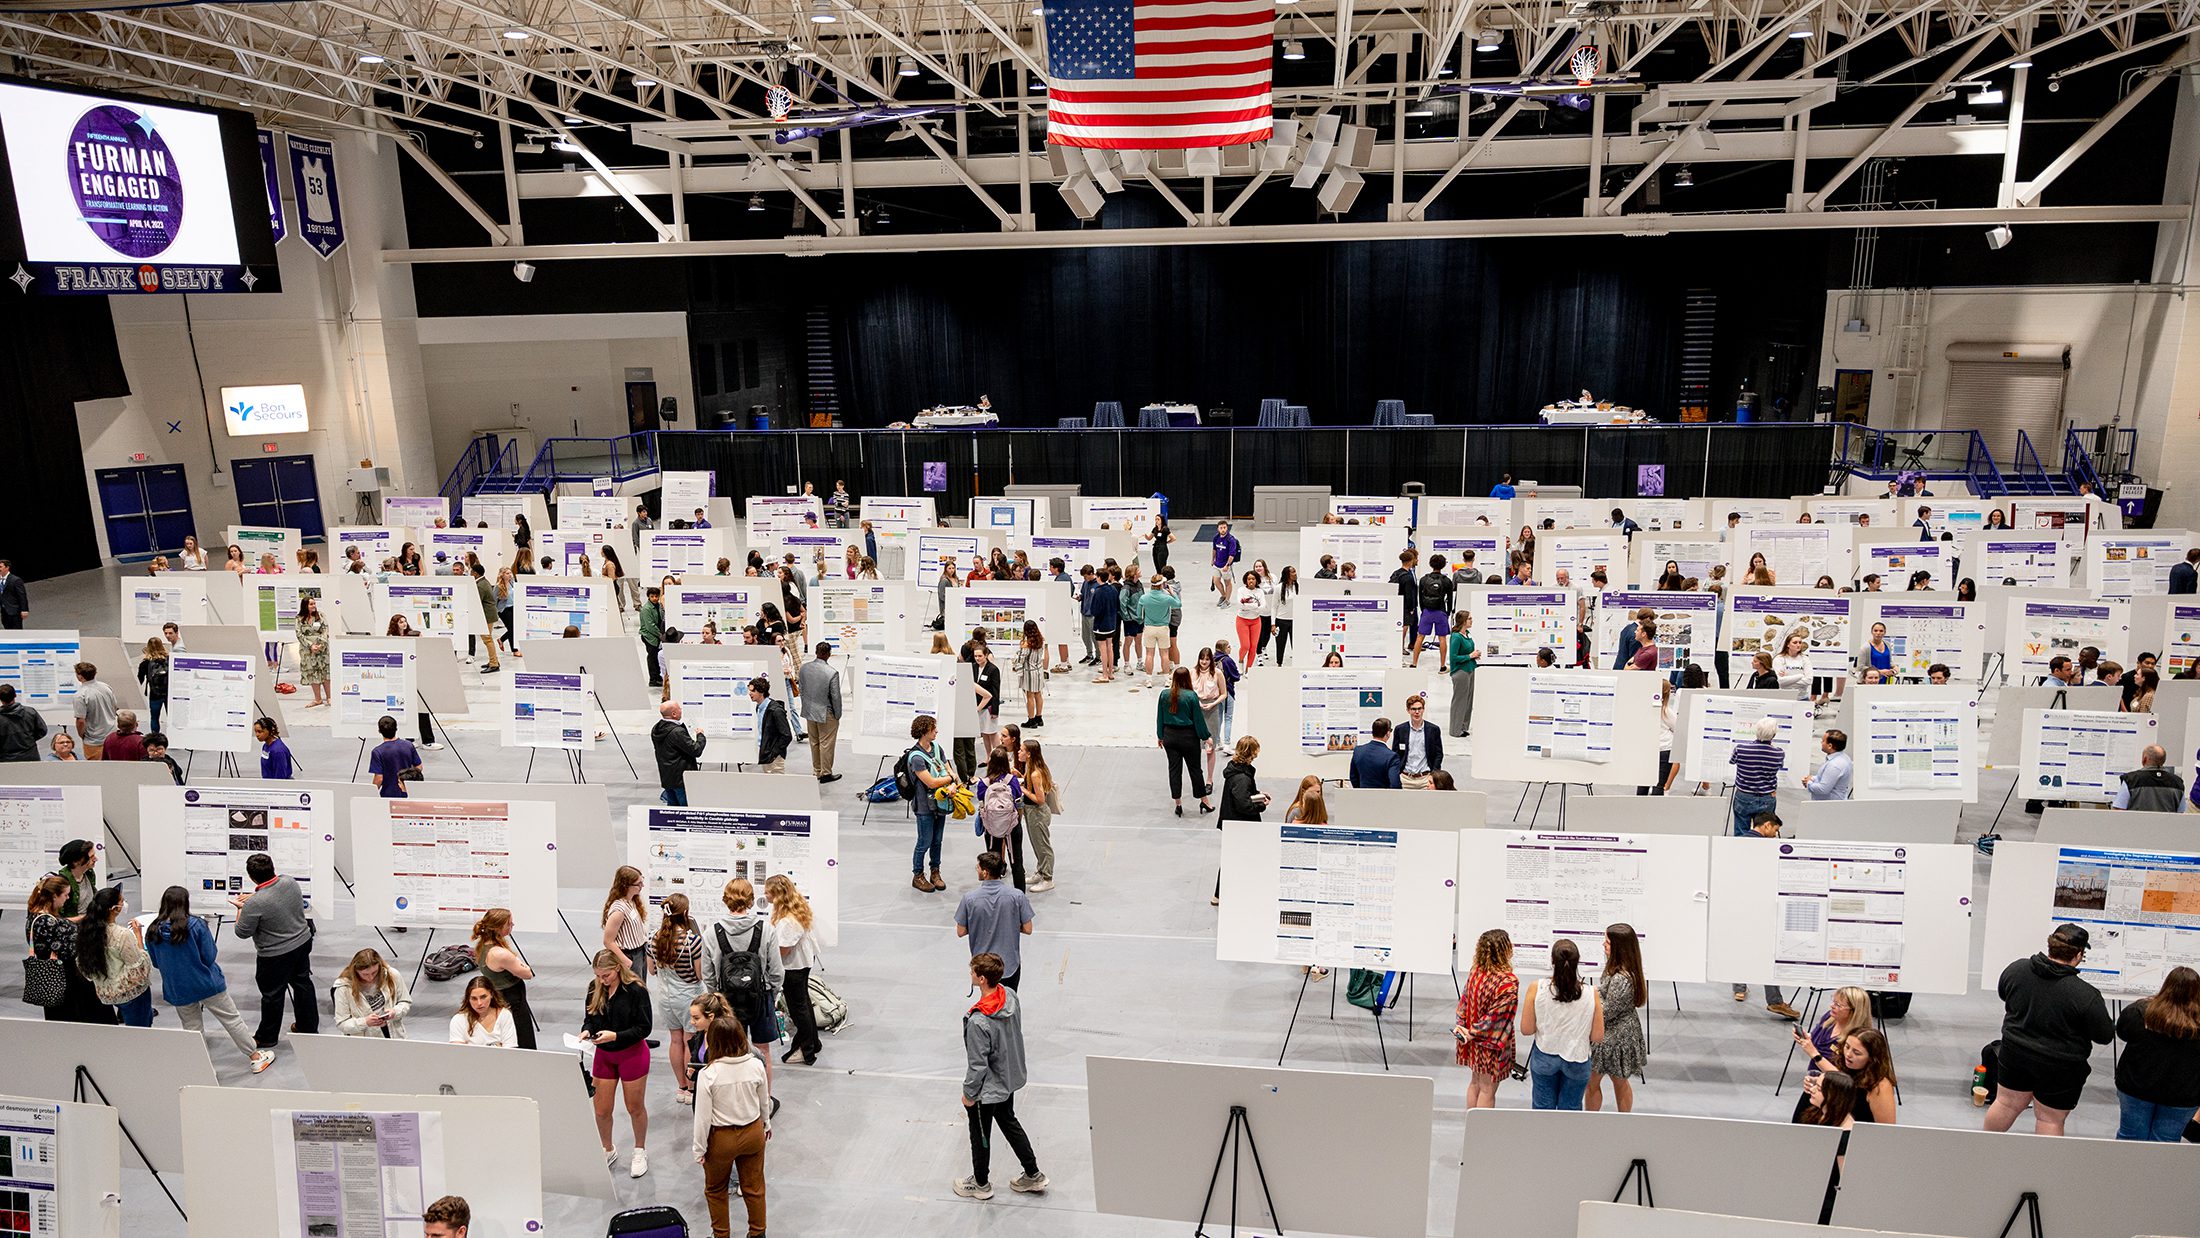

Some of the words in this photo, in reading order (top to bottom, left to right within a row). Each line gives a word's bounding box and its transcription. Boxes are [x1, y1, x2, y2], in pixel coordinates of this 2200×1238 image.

[75, 142, 167, 176] FURMAN
[80, 173, 160, 199] ENGAGED
[308, 176, 323, 196] 53
[85, 200, 125, 210] TRANSFORMATIVE
[126, 202, 146, 211] LEARNING
[153, 204, 168, 212] ACTION
[130, 219, 144, 228] APRIL
[152, 220, 164, 228] 2023
[55, 267, 136, 290] FRANK
[138, 271, 157, 286] 100
[162, 268, 224, 290] SELVY
[254, 411, 302, 421] Secours
[261, 403, 285, 413] Bon
